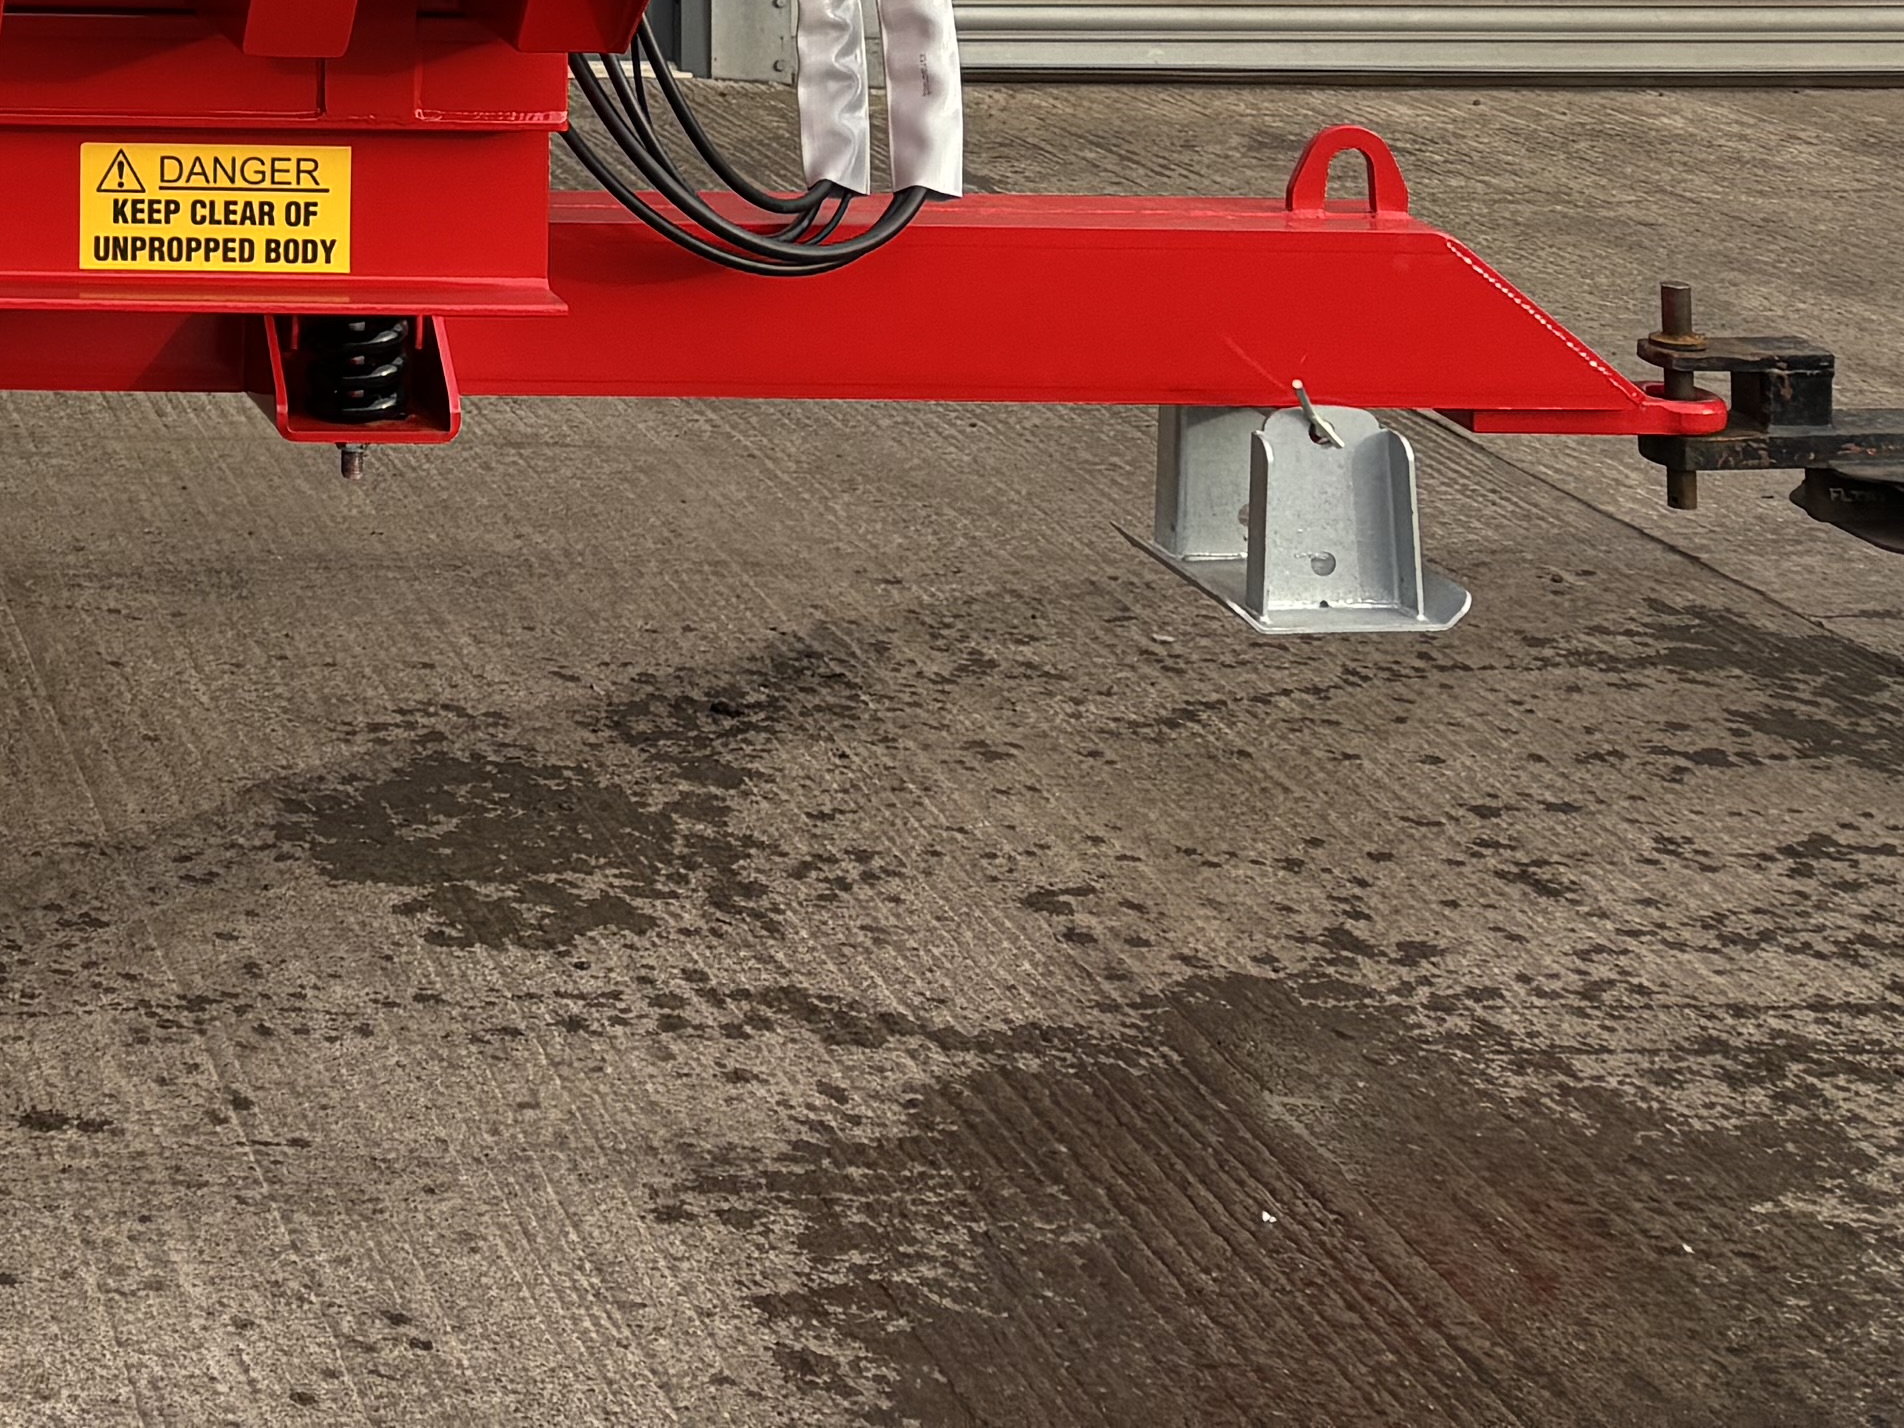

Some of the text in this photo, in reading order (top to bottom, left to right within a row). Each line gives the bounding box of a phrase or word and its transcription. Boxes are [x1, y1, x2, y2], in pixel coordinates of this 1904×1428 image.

[159, 155, 321, 186] DANGER
[112, 198, 319, 227] KEEP CLEAR OF
[93, 235, 337, 265] UNPROPPED BODY
